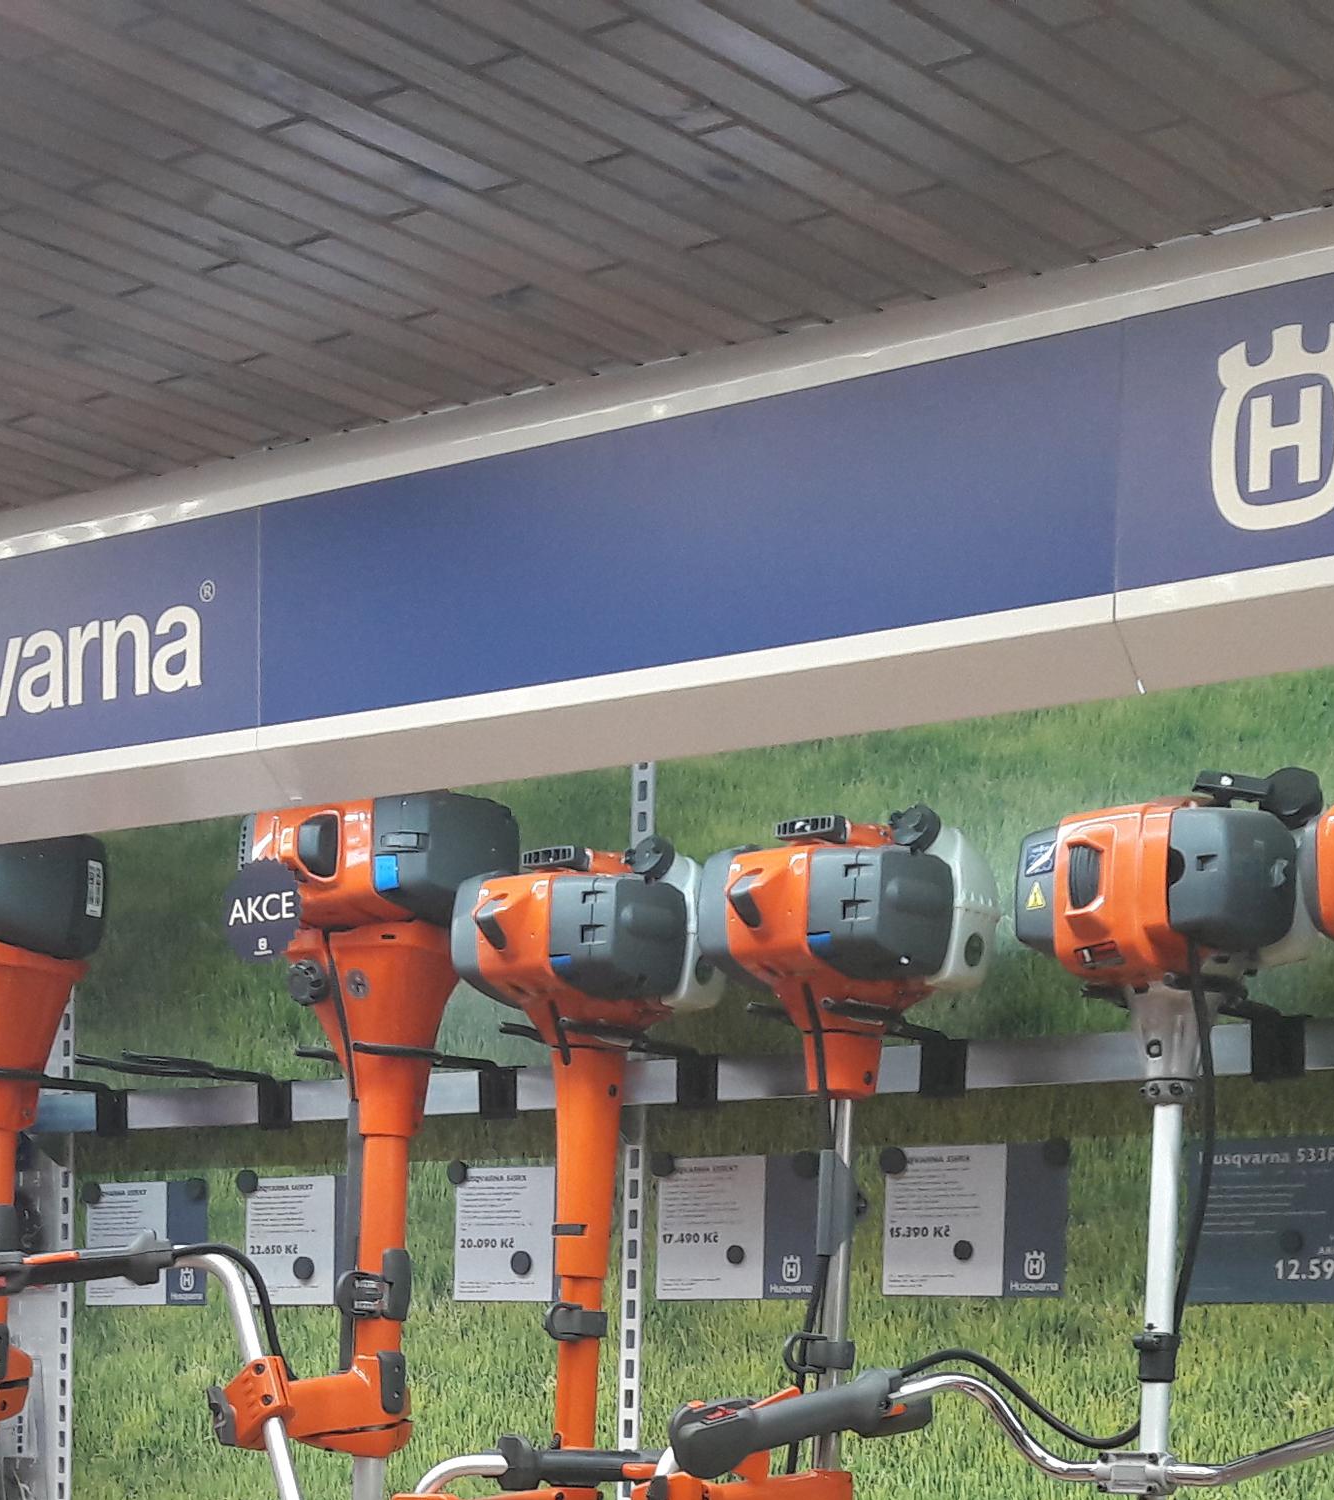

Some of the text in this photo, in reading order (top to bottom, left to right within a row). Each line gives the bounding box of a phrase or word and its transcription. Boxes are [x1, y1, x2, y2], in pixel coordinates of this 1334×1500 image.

[228, 890, 296, 927] AKCE
[703, 1231, 719, 1244] Kč
[889, 1224, 951, 1238] 15.390 Kč
[460, 1237, 515, 1249] 20.090 Kč
[284, 1245, 299, 1255] Kč
